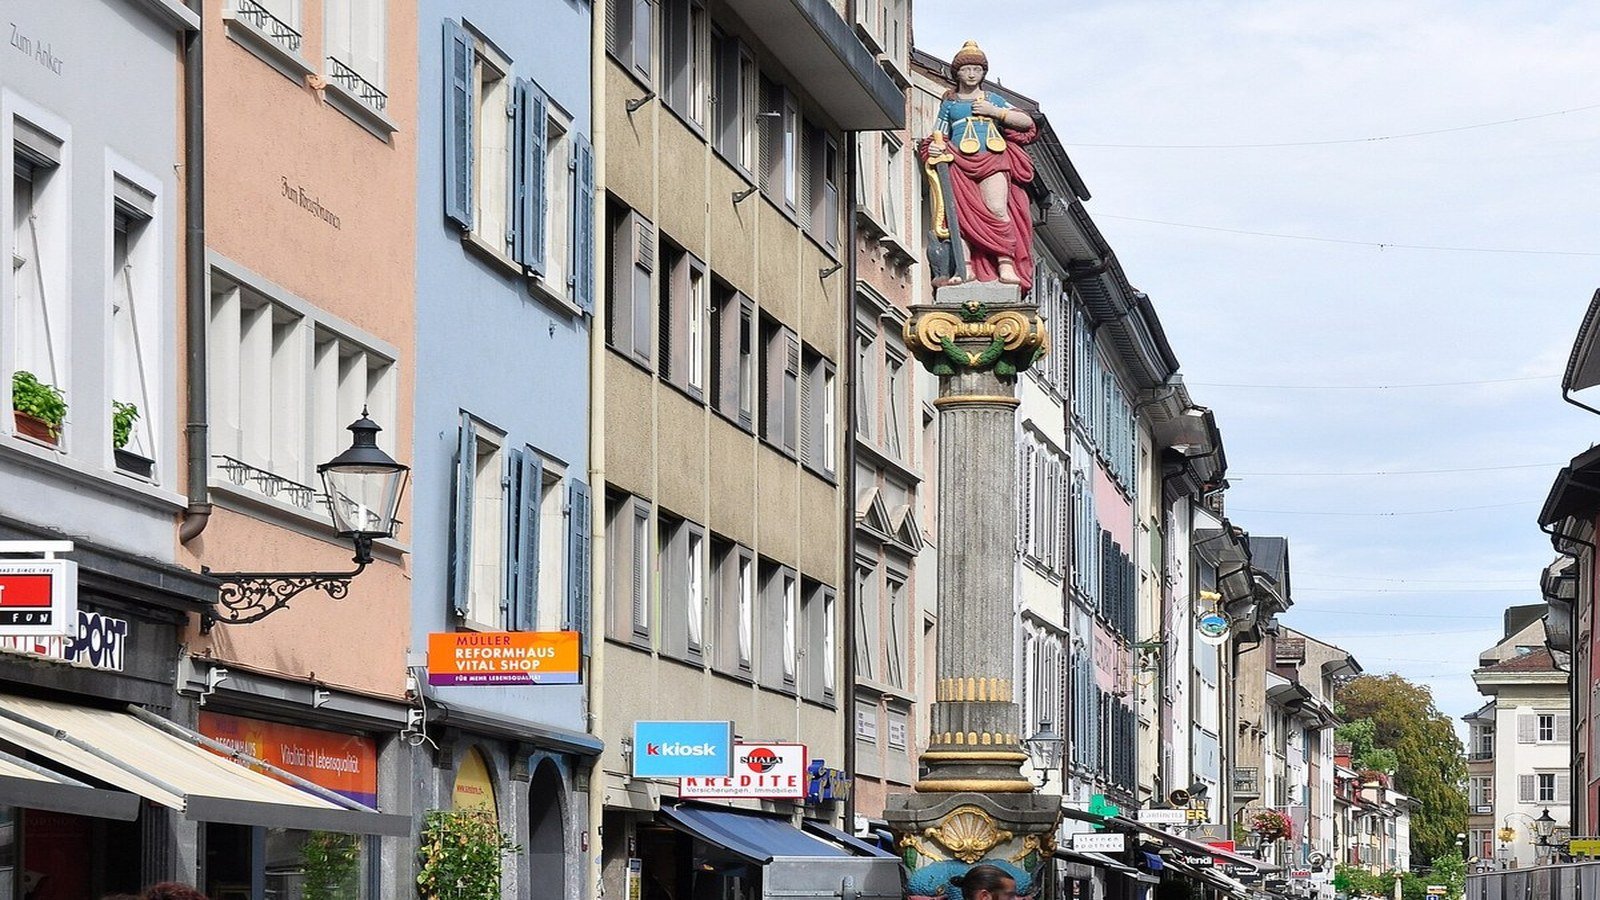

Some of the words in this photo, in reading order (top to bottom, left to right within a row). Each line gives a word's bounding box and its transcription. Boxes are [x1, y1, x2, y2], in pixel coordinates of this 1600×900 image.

[10, 22, 32, 56] Zum
[35, 40, 63, 77] Anker
[12, 613, 49, 623] FUN
[456, 633, 511, 646] MÜLLER
[455, 647, 555, 659] REFORMHAUS
[455, 660, 496, 671] VITAL
[500, 659, 541, 671] SHOP
[455, 673, 468, 682] FÜR
[661, 741, 717, 756] kiosk
[306, 748, 314, 767] ist
[686, 775, 797, 787] KREDITE
[1185, 856, 1212, 865] Yendi
